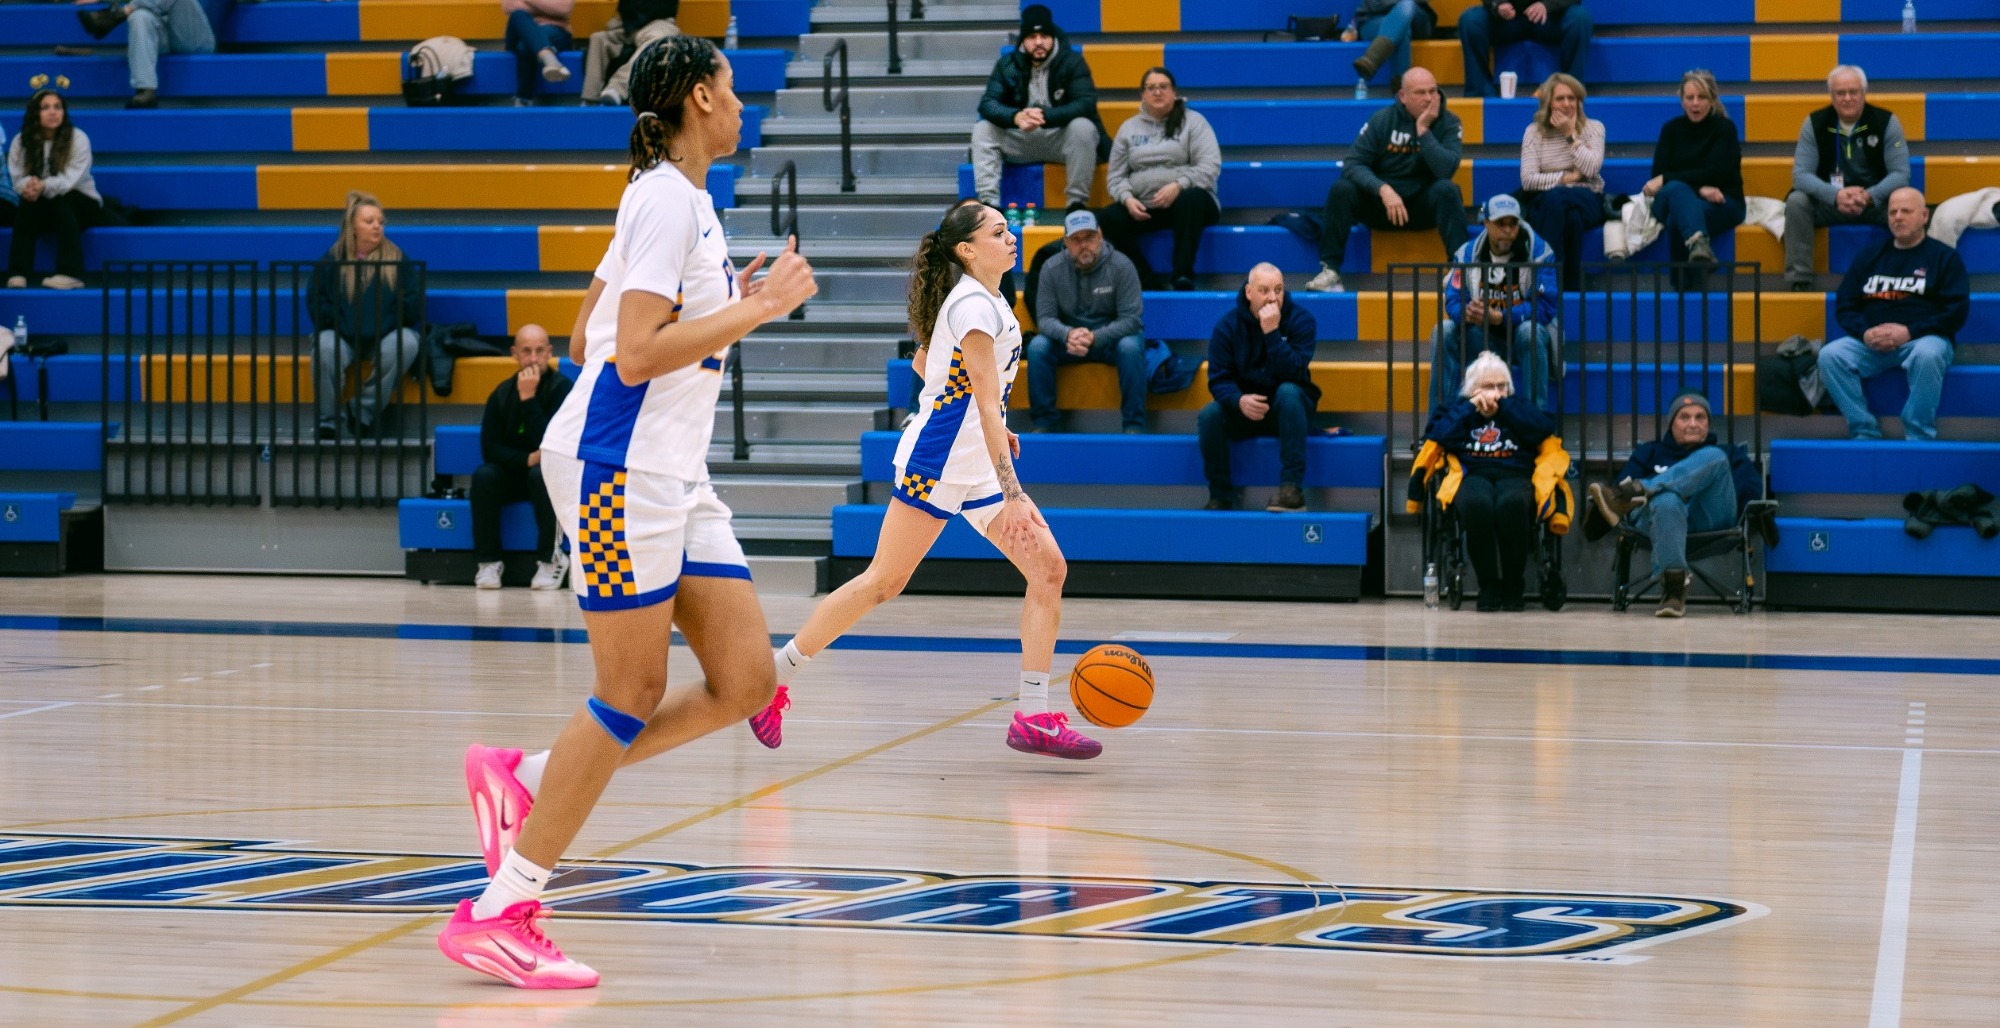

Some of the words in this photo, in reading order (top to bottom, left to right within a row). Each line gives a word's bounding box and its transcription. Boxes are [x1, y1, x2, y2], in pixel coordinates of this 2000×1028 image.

[1863, 274, 1926, 296] UTICA
[1003, 345, 1021, 372] P
[0, 838, 1708, 952] ILDCATS
